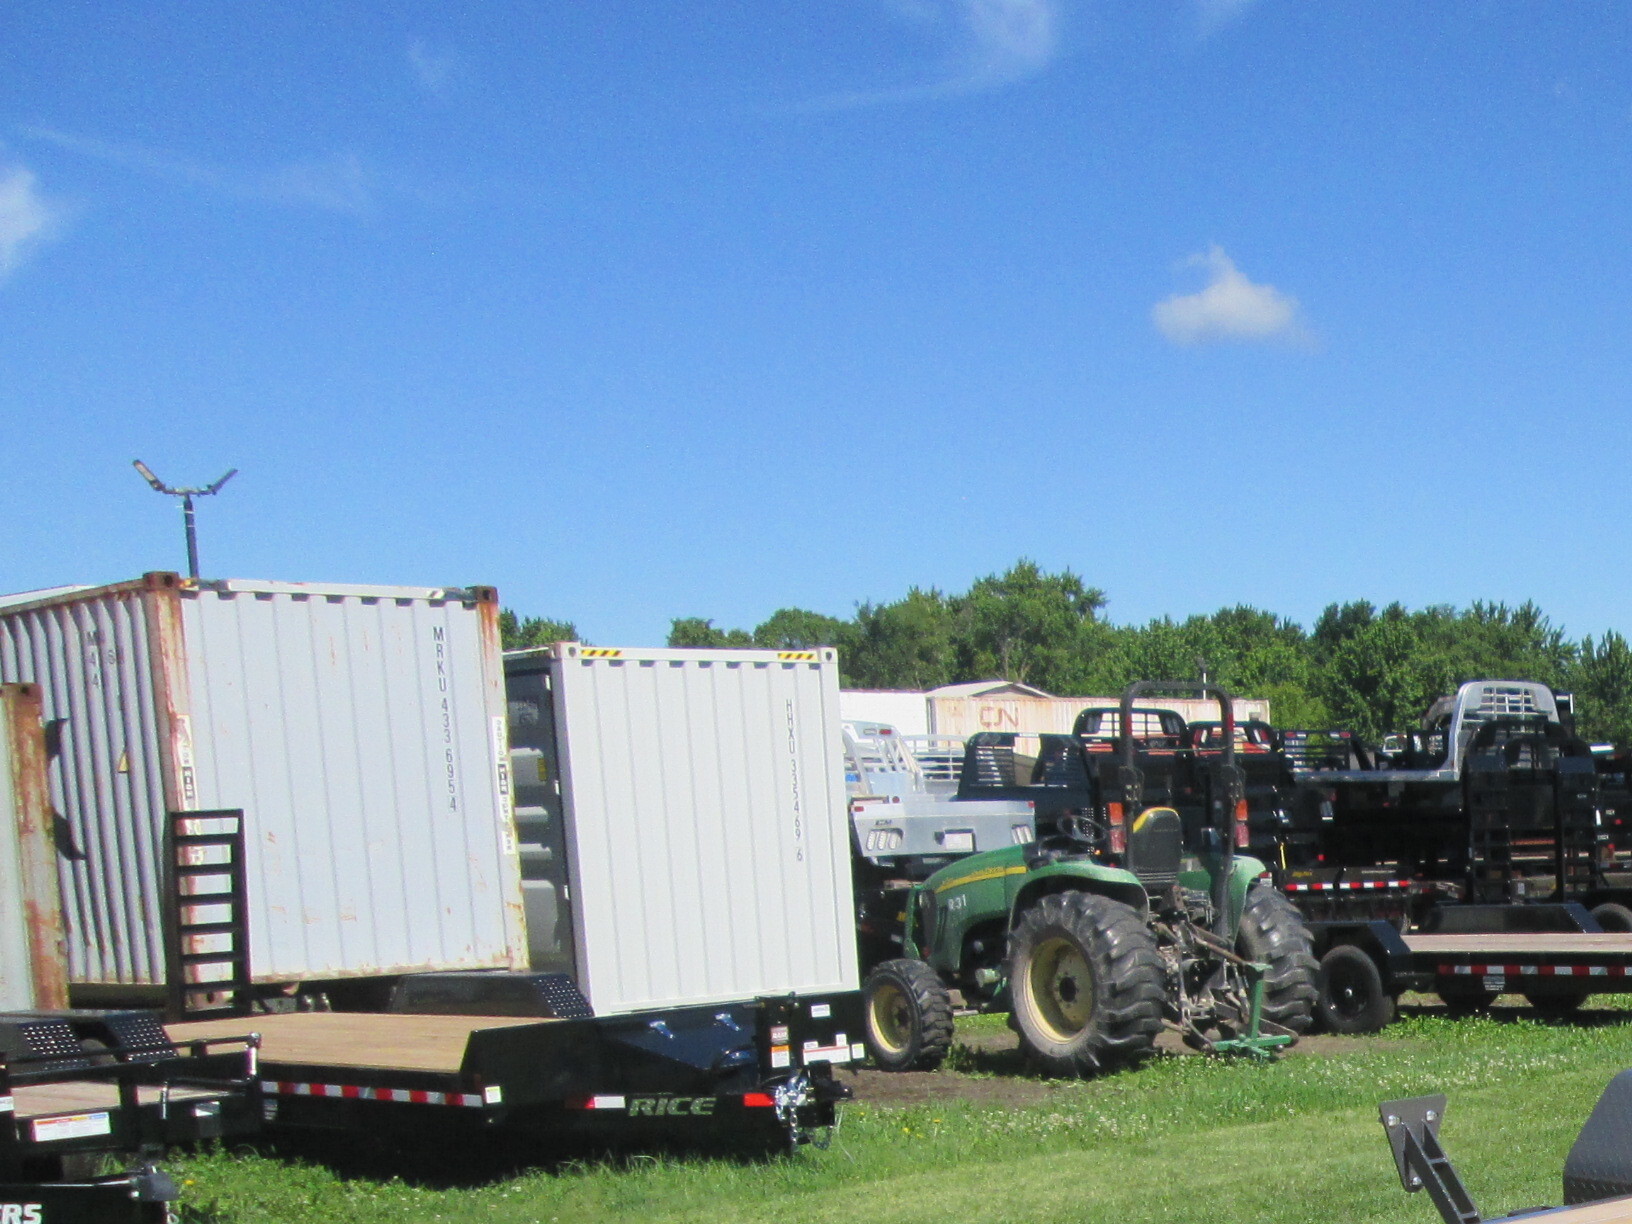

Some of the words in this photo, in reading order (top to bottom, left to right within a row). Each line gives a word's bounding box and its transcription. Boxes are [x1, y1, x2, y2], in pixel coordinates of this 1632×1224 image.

[433, 626, 447, 692] MRKU
[980, 706, 1019, 728] CN
[628, 1097, 717, 1117] RICE
